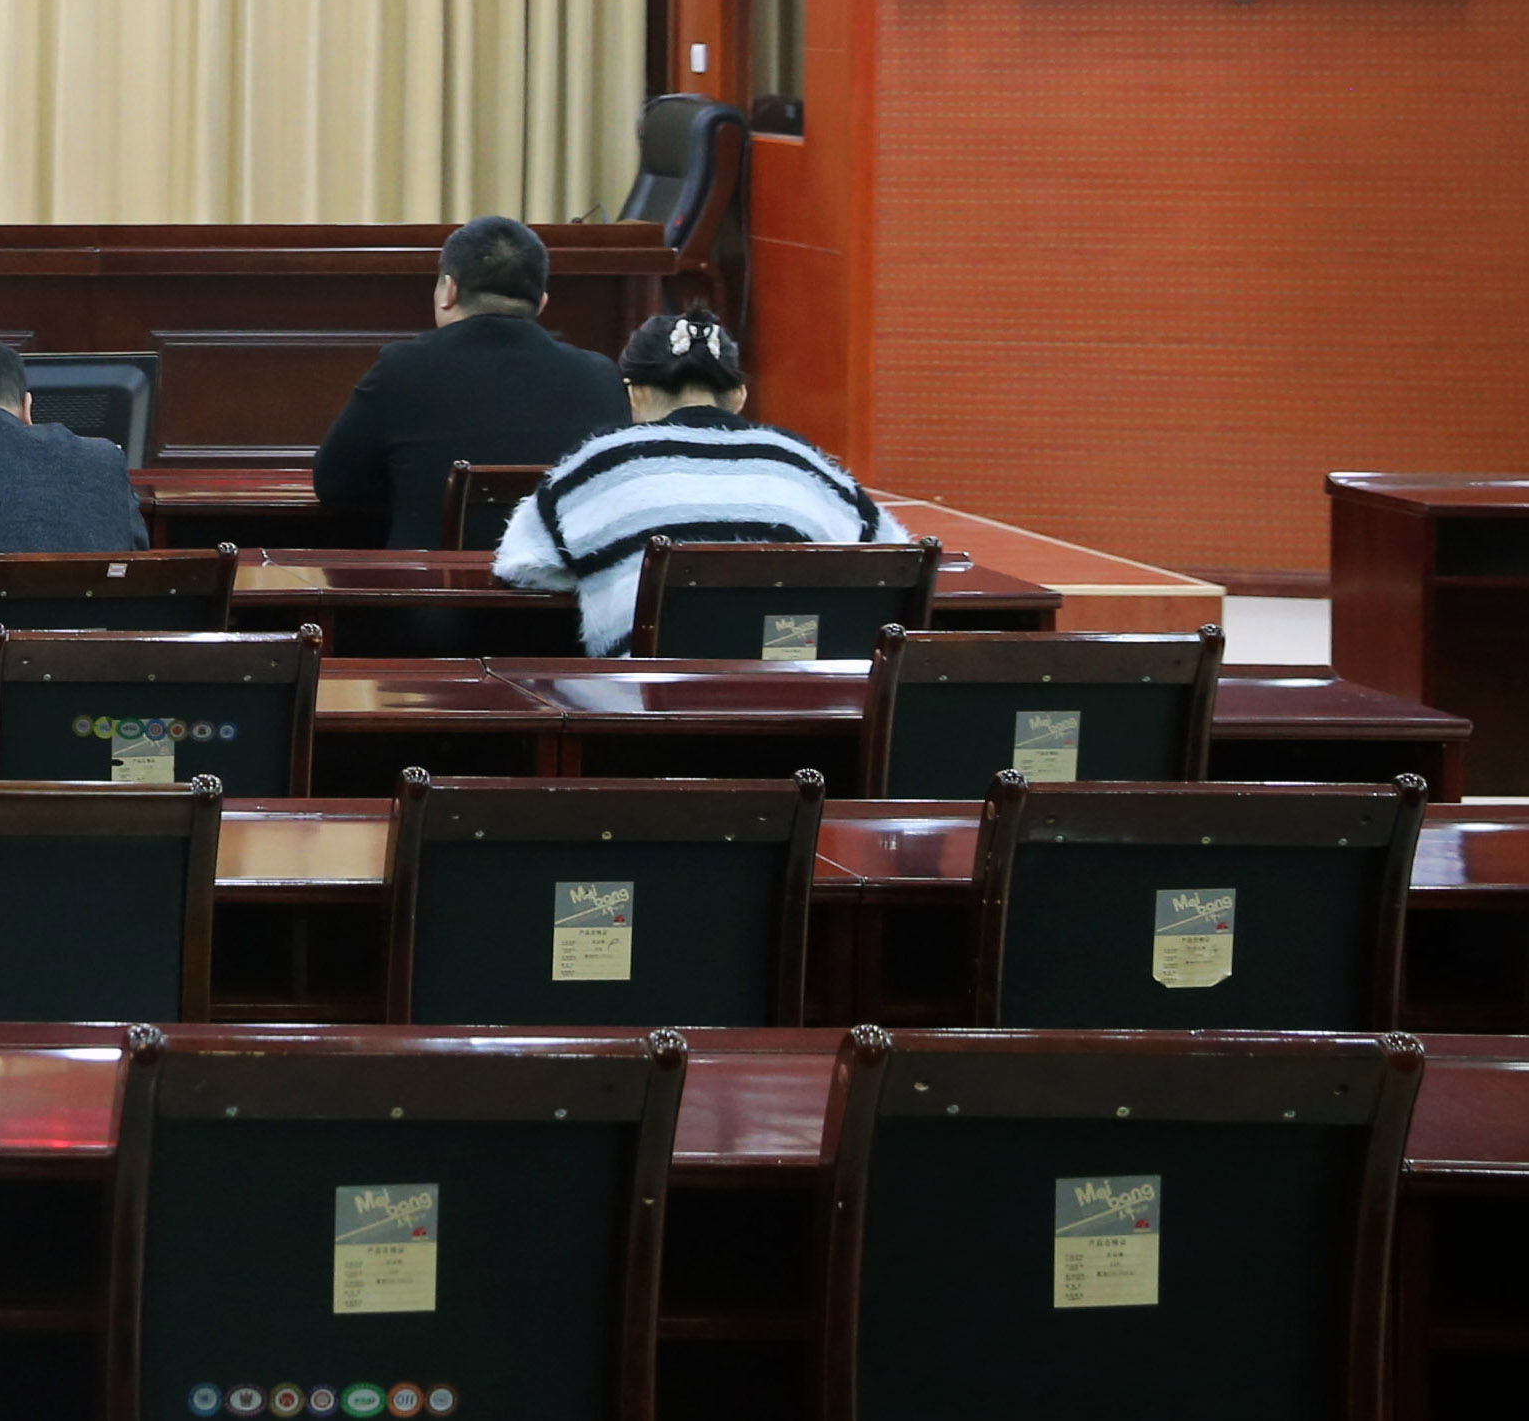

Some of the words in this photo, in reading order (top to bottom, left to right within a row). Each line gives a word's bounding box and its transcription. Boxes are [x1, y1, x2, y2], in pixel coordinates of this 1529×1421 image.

[595, 888, 630, 907] bang
[1172, 892, 1200, 912] Mei
[1197, 896, 1233, 915] bang
[354, 1189, 390, 1214] Mei
[386, 1192, 433, 1218] bang
[1074, 1180, 1111, 1206] Mei
[1107, 1184, 1155, 1209] bang
